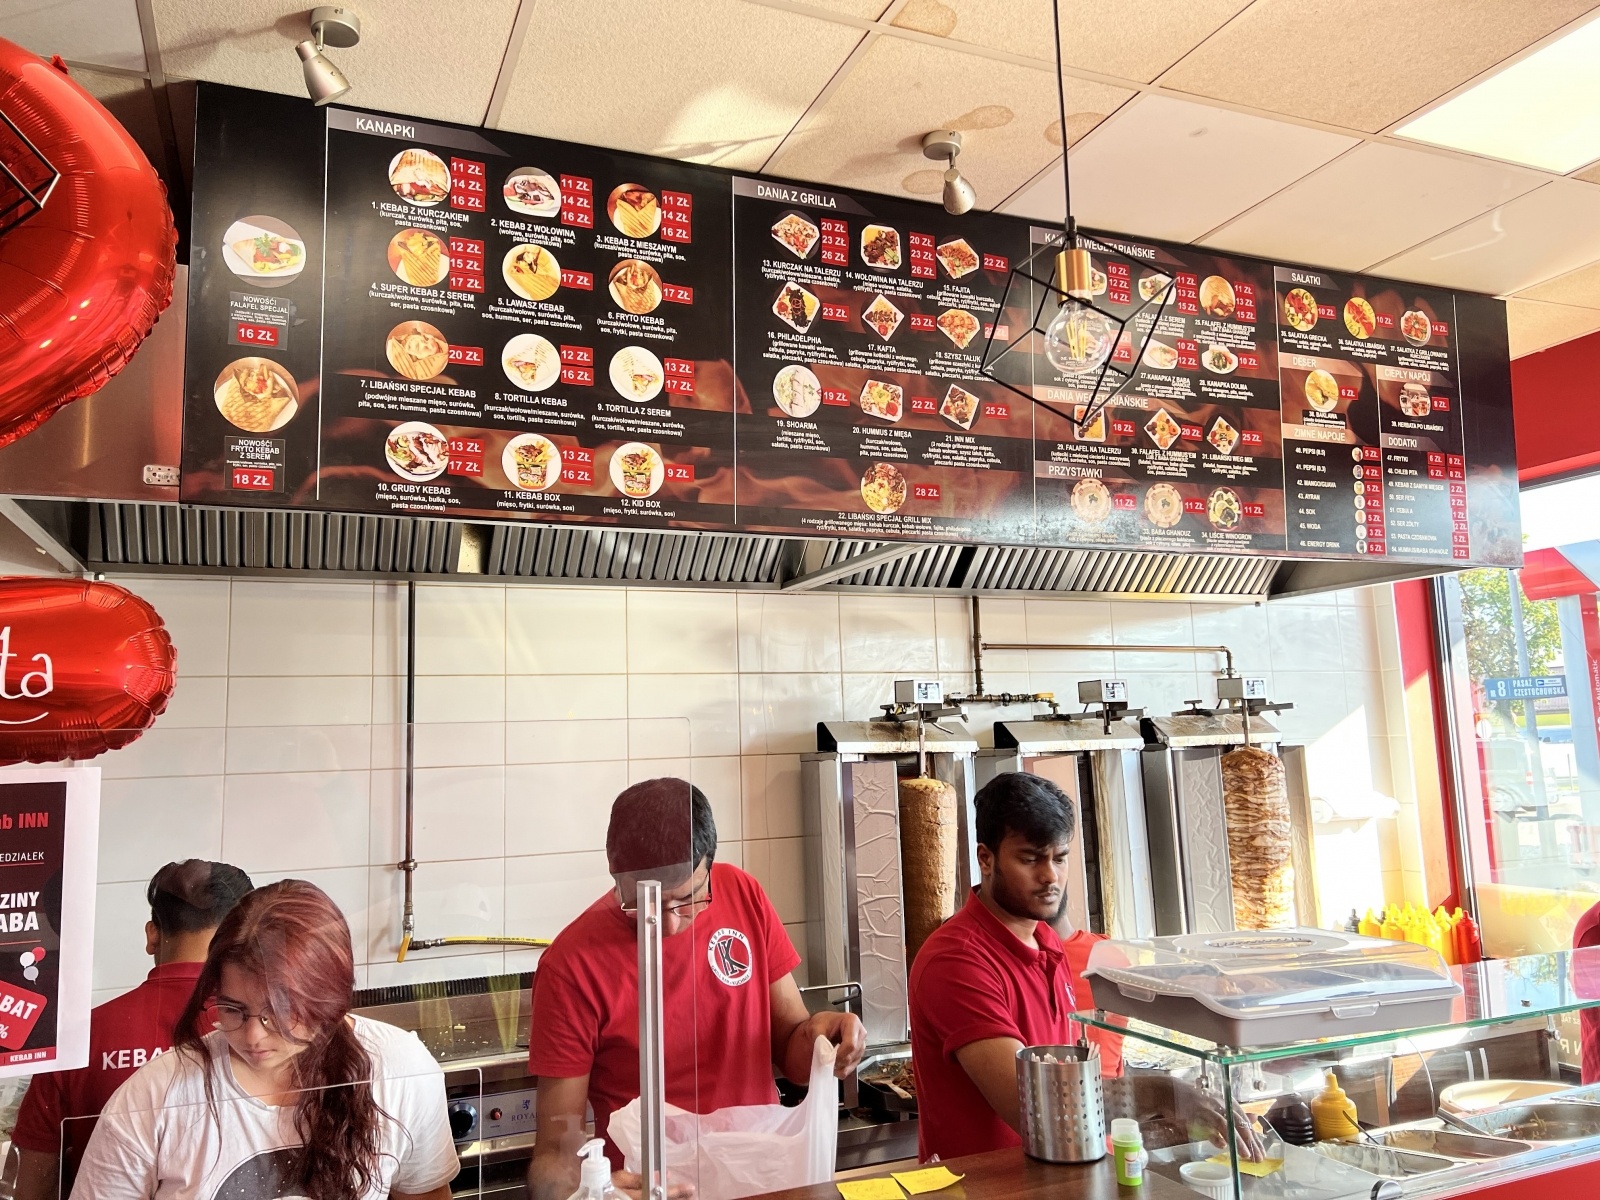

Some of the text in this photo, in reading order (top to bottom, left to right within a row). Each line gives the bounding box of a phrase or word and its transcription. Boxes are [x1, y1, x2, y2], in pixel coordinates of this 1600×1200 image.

[356, 118, 414, 138] KANAPKI
[451, 162, 482, 176] 11 ZŁ
[451, 195, 482, 209] 16 ZŁ
[757, 185, 836, 209] DANIA Z GRILLA
[371, 202, 469, 222] 1. KEBAB Z KURCZAKIEM
[562, 212, 590, 224] 16 ZŁ
[490, 219, 575, 239] 2. KEBAB Z WOŁOWINĄ
[661, 227, 688, 239] 16 ZŁ
[821, 221, 846, 233] 20 ZŁ
[596, 235, 602, 244] 3.
[604, 236, 629, 247] KEBAB
[629, 240, 635, 248] Z
[762, 259, 841, 277] 13. KURCZAK NA TALERZU
[983, 257, 1006, 269] 22 ZŁ
[450, 276, 481, 289] 17 ZŁ
[845, 271, 923, 289] 14. WOŁOWINA NA TALERZU
[1291, 273, 1320, 285] SAŁATKI
[371, 282, 474, 302] 4. SUPER KEBAB Z SEREM
[1109, 291, 1129, 303] 14 ZŁ
[230, 301, 259, 310] FALAFEL
[497, 298, 564, 313] 5. LAWASZ KEBAB
[1178, 301, 1197, 313] 15 ZŁ
[607, 311, 664, 326] 6. FRYTO KEBAB
[239, 326, 274, 343] 16 ZŁ
[767, 331, 821, 345] 16. PHILADELPHIA
[867, 343, 896, 354] 17. KAFTA
[1292, 356, 1316, 368] DESER
[1384, 368, 1430, 382] CIEPŁY NAPÓJ
[360, 379, 476, 398] 7. LIBAŃSKI SPECJAŁ KEBAB
[666, 380, 693, 391] 17 ZŁ
[1048, 390, 1074, 400] DANIA
[1341, 388, 1355, 398] 6 ZŁ
[494, 392, 567, 407] 8. TORTILLA KEBAB
[597, 404, 671, 417] 9. TORTILLA Z SEREM
[776, 420, 817, 430] 19. SHOARMA
[1113, 422, 1133, 433] 18 ZŁ
[852, 426, 912, 440] 20. HUMMUS Z MIĘSA
[1294, 429, 1345, 441] ZIMNE NAPOJE
[1388, 437, 1417, 448] DODATKI
[230, 445, 279, 456] FRYTO KEBAB
[239, 451, 270, 462] Z SEREM
[1429, 455, 1442, 464] 6 ZŁ
[1048, 465, 1102, 479] PRZYSTAWKI
[234, 473, 270, 488] 18 ZŁ
[377, 484, 450, 496] 10. GRUBY KEBAB
[503, 490, 560, 502] 11. KEBAB BOX
[915, 487, 939, 497] 28 ZŁ
[620, 498, 660, 508] 12. KID BOX
[1512, 678, 1532, 687] PASAŻ
[1497, 681, 1506, 697] 8
[1513, 686, 1565, 696] CZĘSTOCHOWSKA
[18, 812, 48, 828] INN
[728, 930, 744, 940] INN
[10, 1051, 46, 1062] KEBAB INN
[102, 1046, 175, 1070] KEBA
